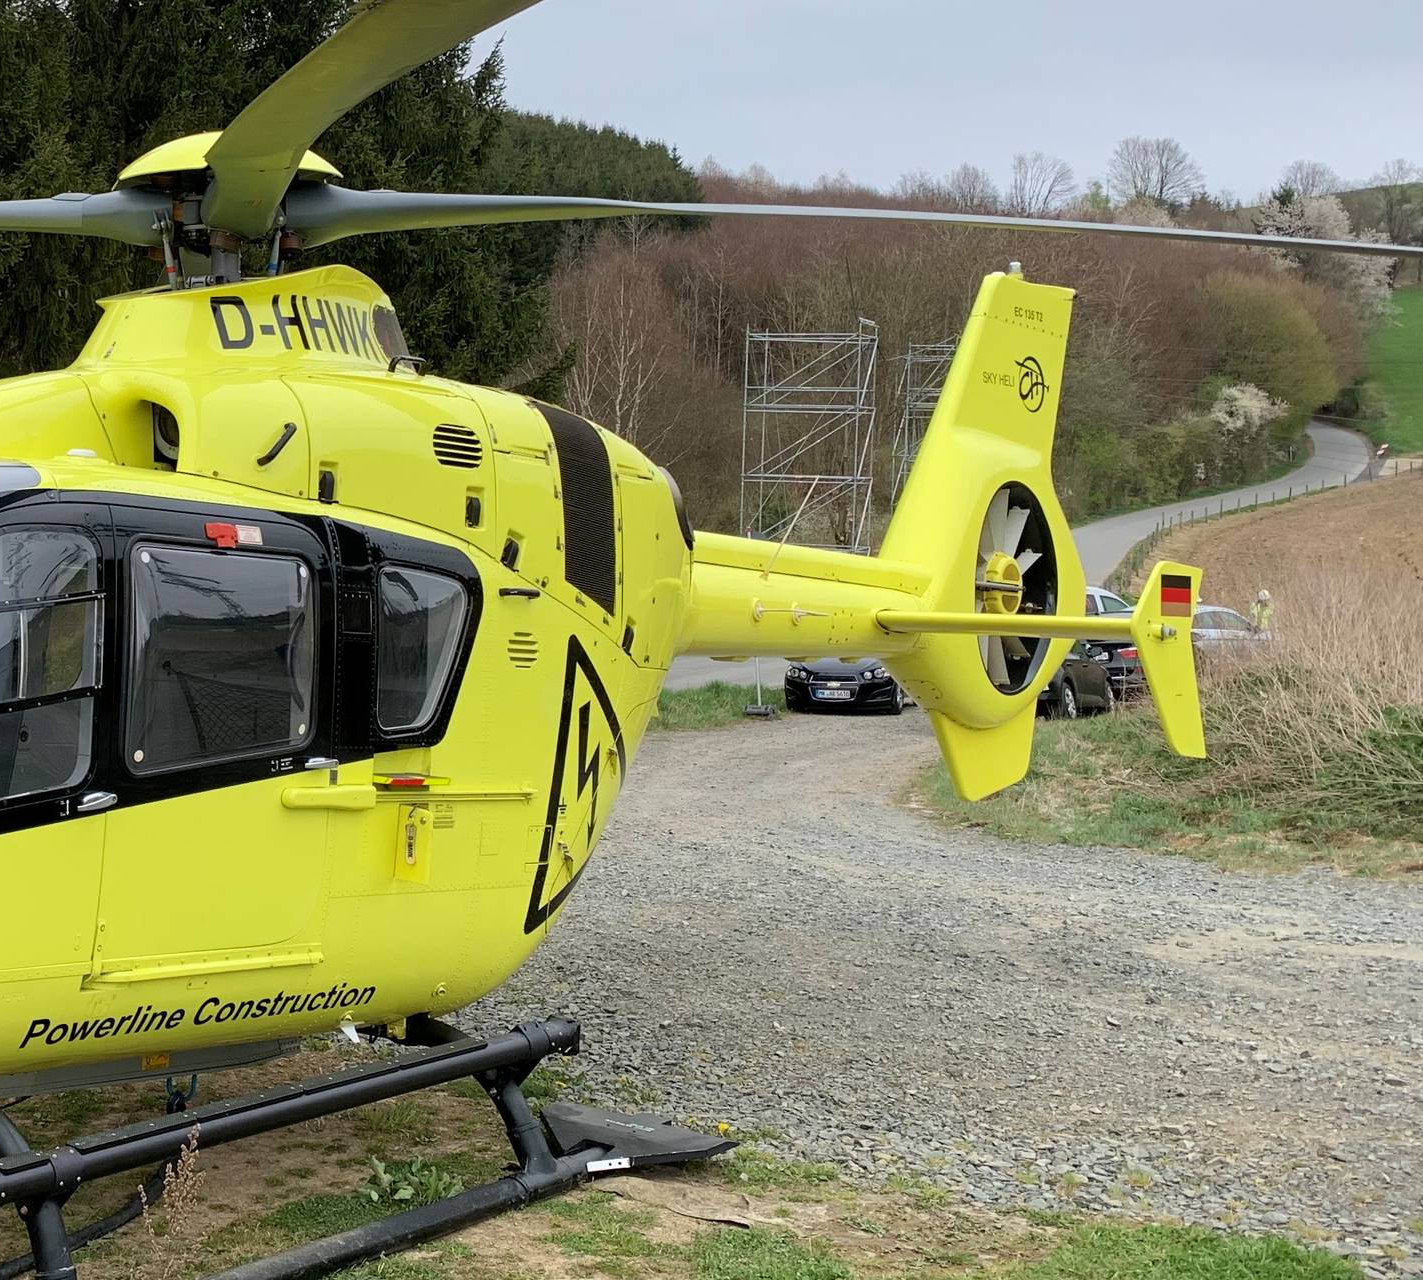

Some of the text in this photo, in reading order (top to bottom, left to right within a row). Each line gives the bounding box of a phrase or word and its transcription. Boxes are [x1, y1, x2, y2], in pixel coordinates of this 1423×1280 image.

[210, 294, 381, 364] D-HHWK
[1014, 306, 1043, 322] EC 135 T2
[982, 371, 1015, 387] SKY HELI
[19, 982, 377, 1049] Powerline Construction
